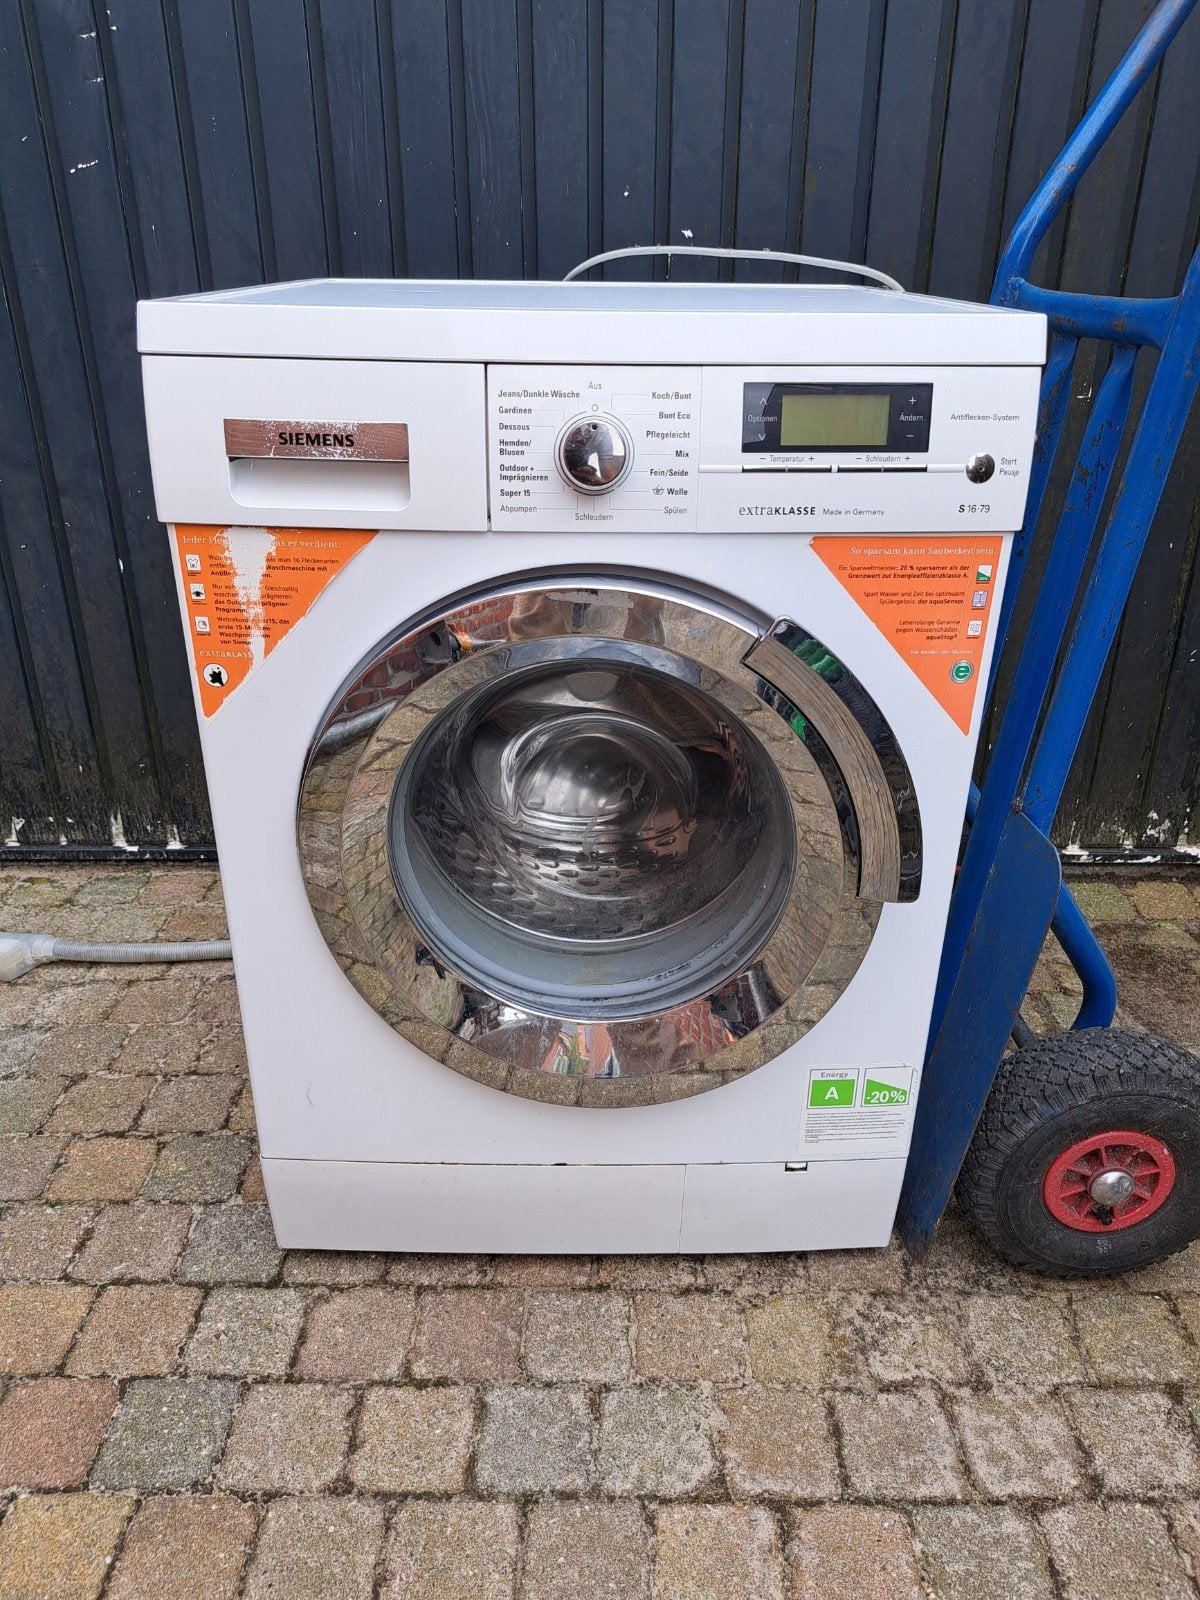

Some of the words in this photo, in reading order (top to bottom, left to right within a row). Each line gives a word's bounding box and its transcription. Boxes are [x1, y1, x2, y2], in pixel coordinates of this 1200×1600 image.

[588, 382, 602, 390] Aus
[498, 390, 549, 398] Jeans/Dunkle
[550, 390, 580, 398] Wäsche
[652, 392, 692, 400] Koch/Bunt
[499, 406, 532, 414] Gardinen
[747, 414, 778, 423] Optionen
[900, 413, 923, 422] Ändern
[950, 413, 1020, 422] Antiflecken-System
[499, 423, 530, 431] Dessous
[646, 430, 690, 439] Pflegeleicht
[278, 432, 355, 447] SIEMENS
[499, 439, 532, 448] Hemden/
[499, 448, 525, 456] Blusen
[769, 455, 805, 464] Temperatur
[865, 455, 901, 463] Schleudern
[1000, 457, 1018, 466] Start
[649, 469, 689, 477] Fein/Seide
[999, 468, 1020, 477] Pause
[499, 473, 549, 482] Imprägnieren
[500, 489, 522, 498] Super
[523, 489, 531, 497] 15
[667, 488, 688, 496] Wolle
[500, 505, 537, 513] Abpumpen
[663, 506, 688, 515] Spülen
[738, 505, 816, 516] extraKLASSE
[852, 508, 885, 517] Germany
[958, 504, 965, 513] S
[575, 513, 614, 521] Schleudern
[299, 540, 341, 549] verdient.
[850, 547, 862, 555] So
[863, 548, 901, 556] sparsam
[903, 547, 926, 555] kann
[927, 546, 975, 555] Sauberkeit
[975, 547, 996, 555] sein.
[893, 572, 962, 580] Energieeffizienzklasse
[935, 590, 966, 598] optimalem
[824, 1086, 839, 1100] A
[866, 1090, 906, 1104] -20%
